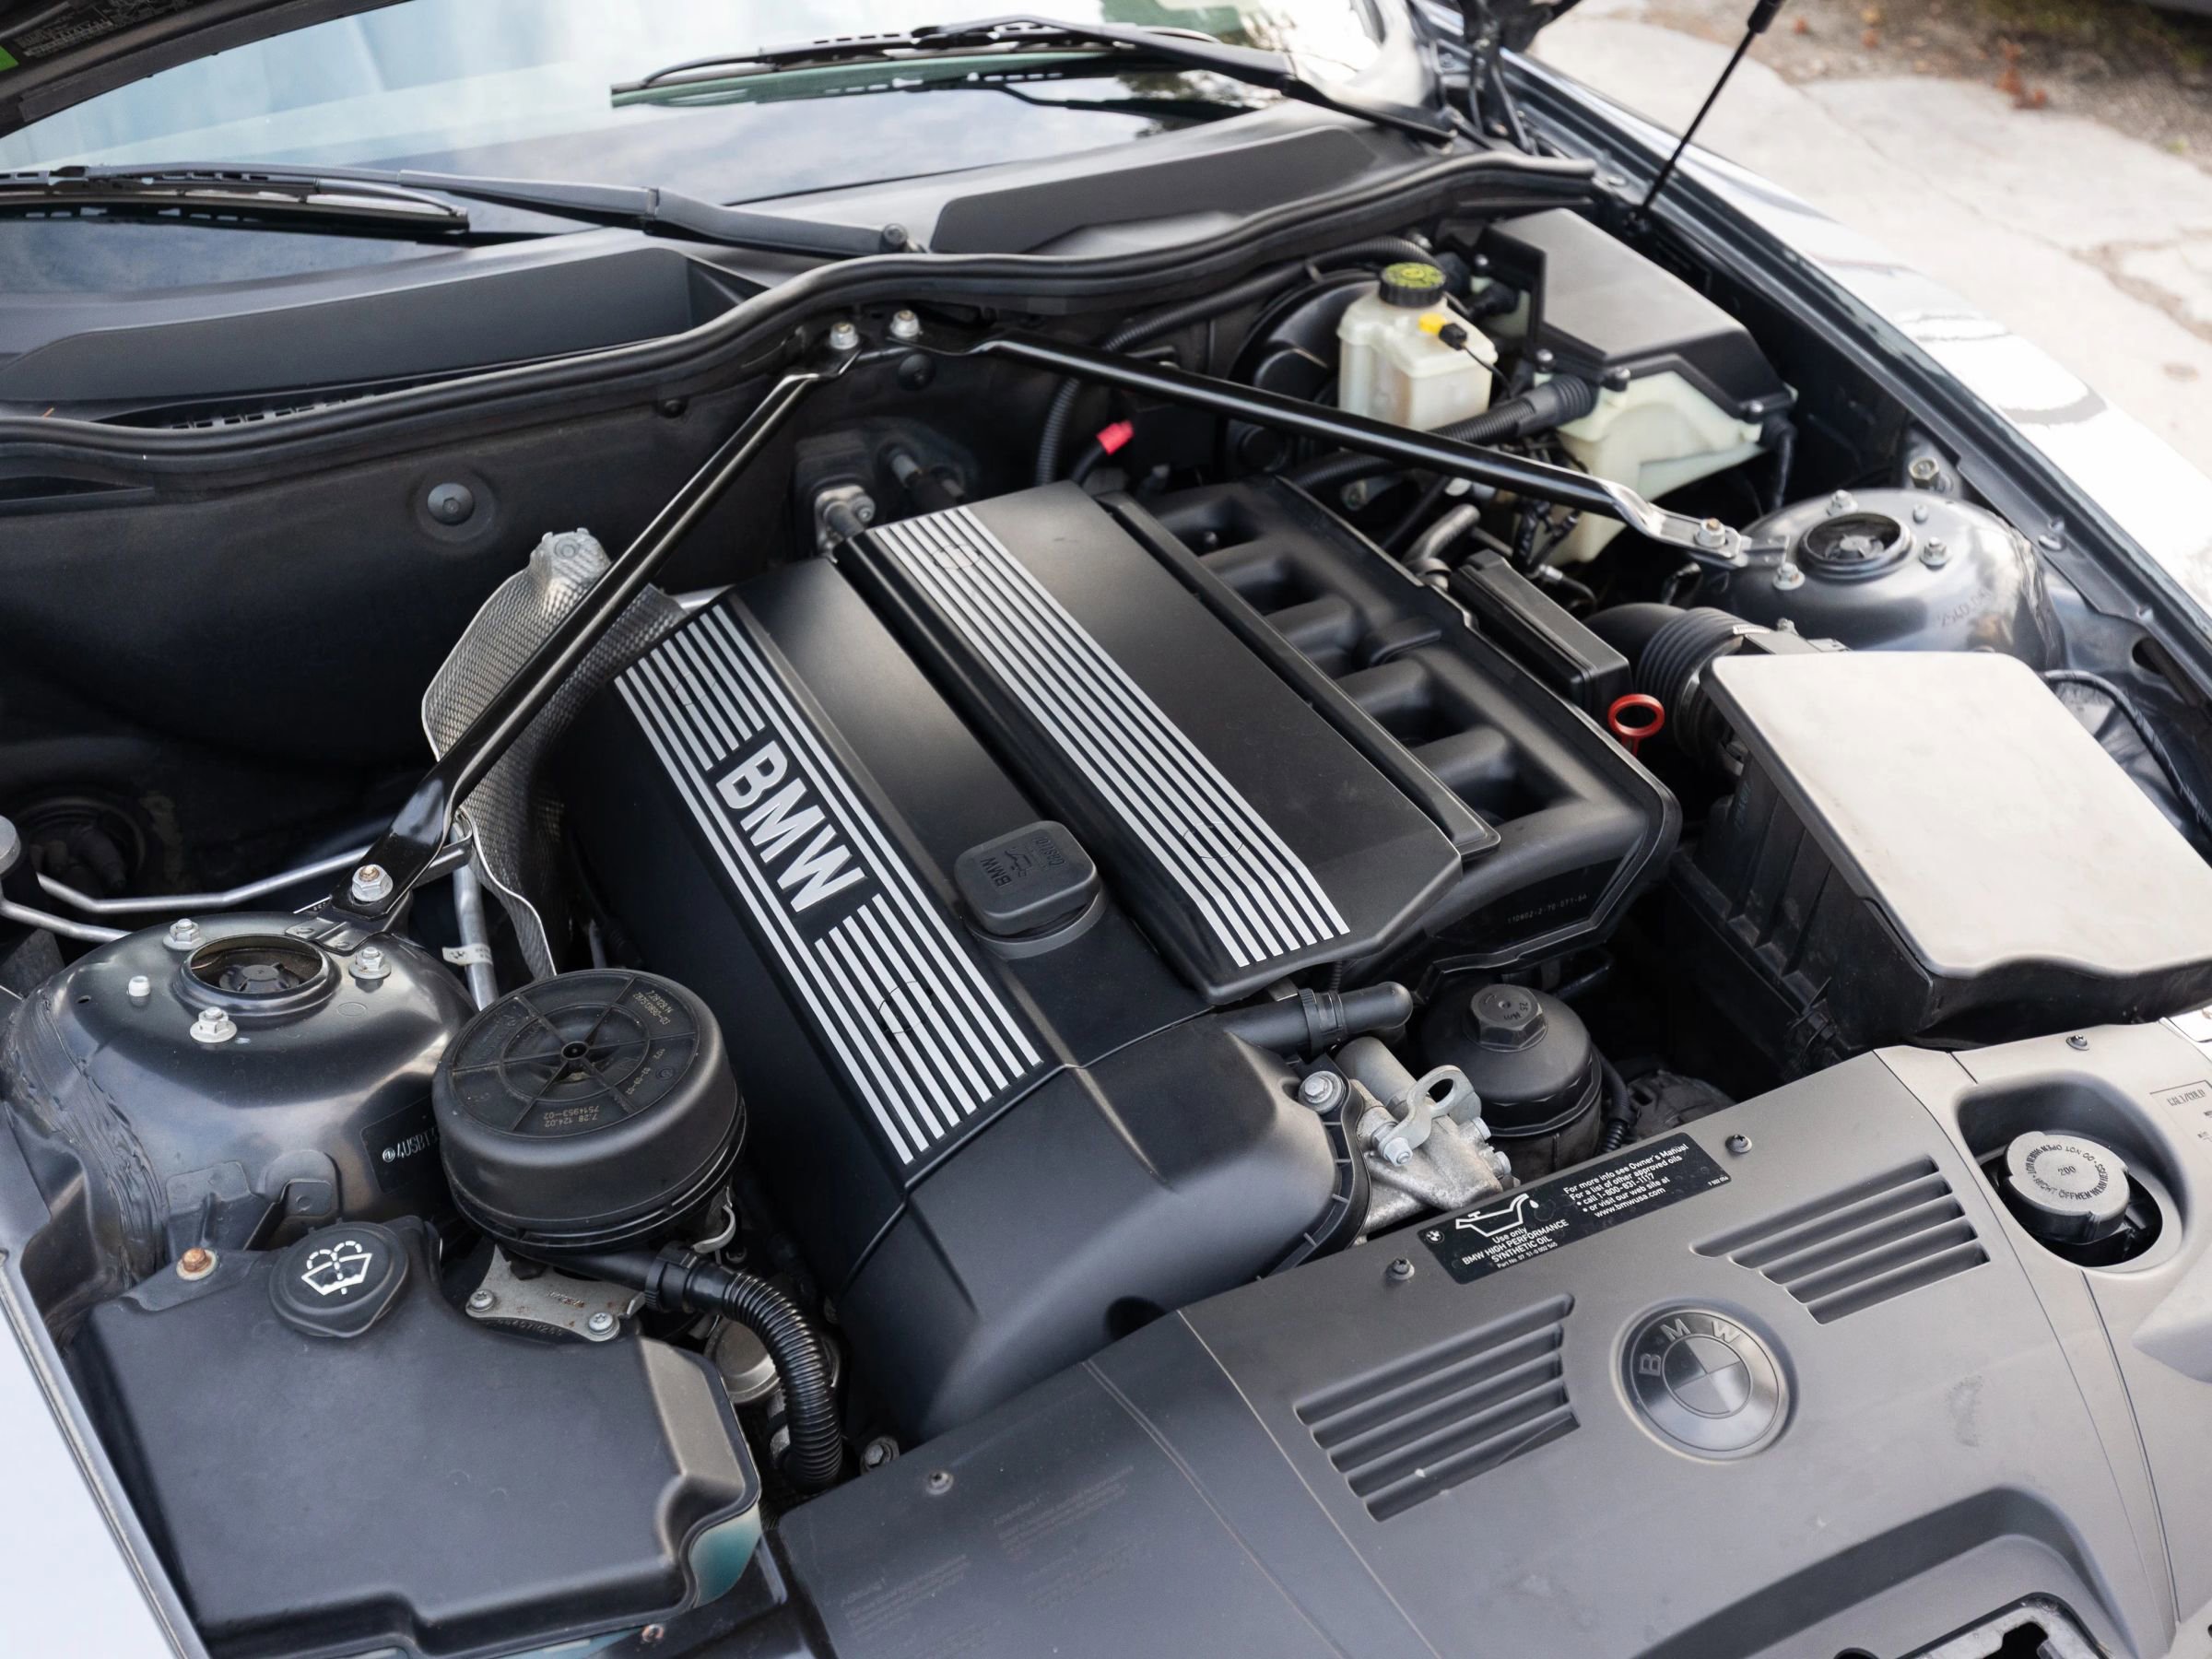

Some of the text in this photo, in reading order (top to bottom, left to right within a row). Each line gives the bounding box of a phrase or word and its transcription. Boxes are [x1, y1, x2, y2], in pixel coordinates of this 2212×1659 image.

[715, 740, 866, 912] BMW
[980, 856, 1013, 887] BMW
[2065, 1145, 2082, 1155] NOT
[2082, 1151, 2095, 1161] DO
[1563, 1143, 1688, 1194] For more info see Owner's Manual
[1569, 1192, 1584, 1200] For
[1590, 1183, 1604, 1193] list
[1604, 1180, 1612, 1188] of
[1613, 1173, 1632, 1184] other
[1633, 1159, 1668, 1176] approved
[1668, 1155, 1683, 1163] oils
[2057, 1165, 2077, 1177] 200
[1583, 1172, 1654, 1205] call 1-800-831-1117
[1594, 1187, 1666, 1218] www.bmwusa.com
[1598, 1196, 1616, 1207] visit
[1615, 1192, 1630, 1202] our
[1630, 1185, 1647, 1195] web
[1646, 1180, 1661, 1189] site
[1661, 1176, 1671, 1184] at
[2058, 1188, 2092, 1200] ÖFFNEN
[1462, 1218, 1569, 1265] BMW HIGH PERFORMANCE
[1491, 1235, 1553, 1263] SYNTHETIC OIL
[1492, 1227, 1527, 1243] Use only
[1639, 1318, 1740, 1376] BMW
